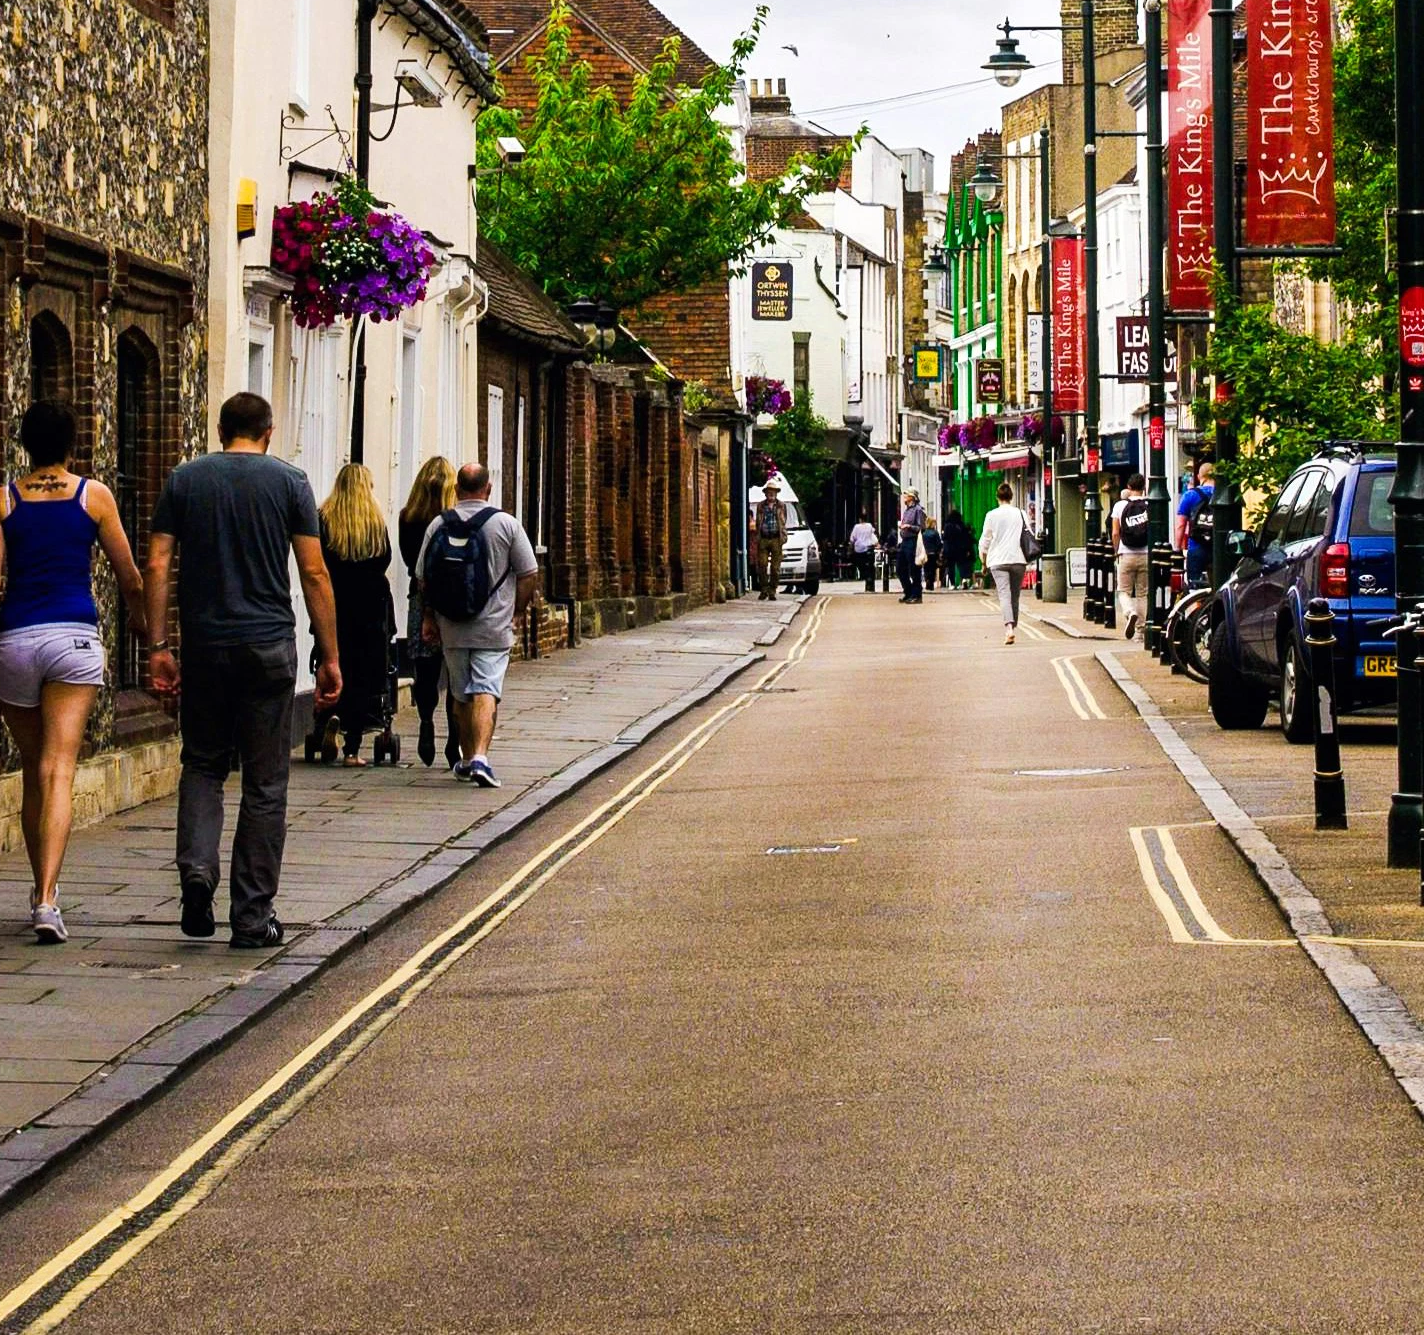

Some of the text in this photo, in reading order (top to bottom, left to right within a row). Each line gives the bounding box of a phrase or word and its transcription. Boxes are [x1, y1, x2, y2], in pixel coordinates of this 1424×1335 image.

[1175, 32, 1208, 238] The King's Mile
[1259, 71, 1293, 145] The
[1056, 258, 1075, 372] The King's Mile
[1029, 318, 1038, 389] GALLERY
[1366, 656, 1397, 673] GR5
